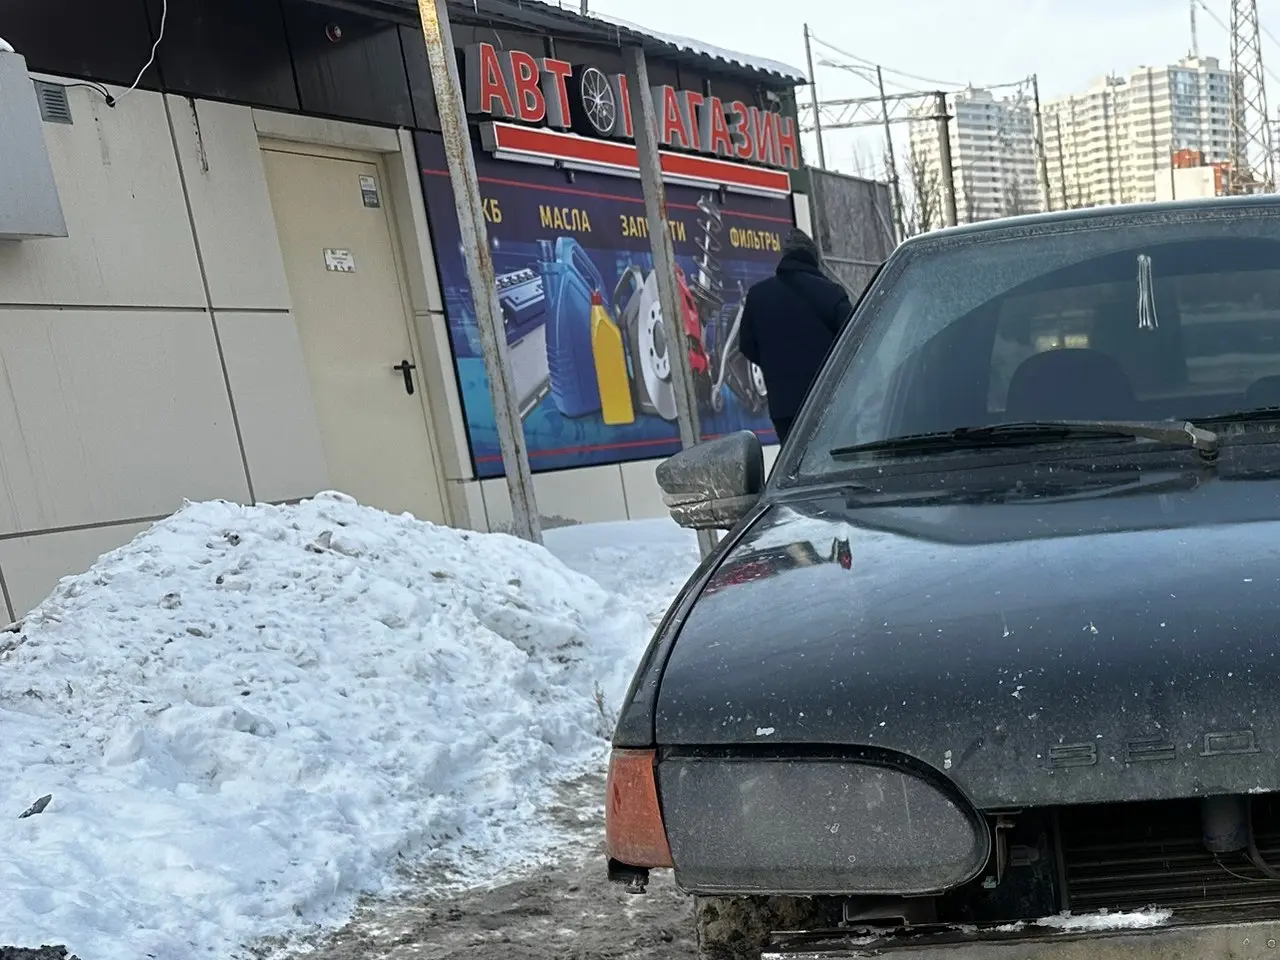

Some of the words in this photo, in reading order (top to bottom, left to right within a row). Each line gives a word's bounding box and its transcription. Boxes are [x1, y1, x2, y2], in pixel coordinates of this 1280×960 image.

[483, 198, 502, 223] КБ
[539, 205, 592, 233] МАСЛА
[620, 214, 686, 242] ЗАПТИ
[729, 227, 781, 252] ФИЛЬТРЫ
